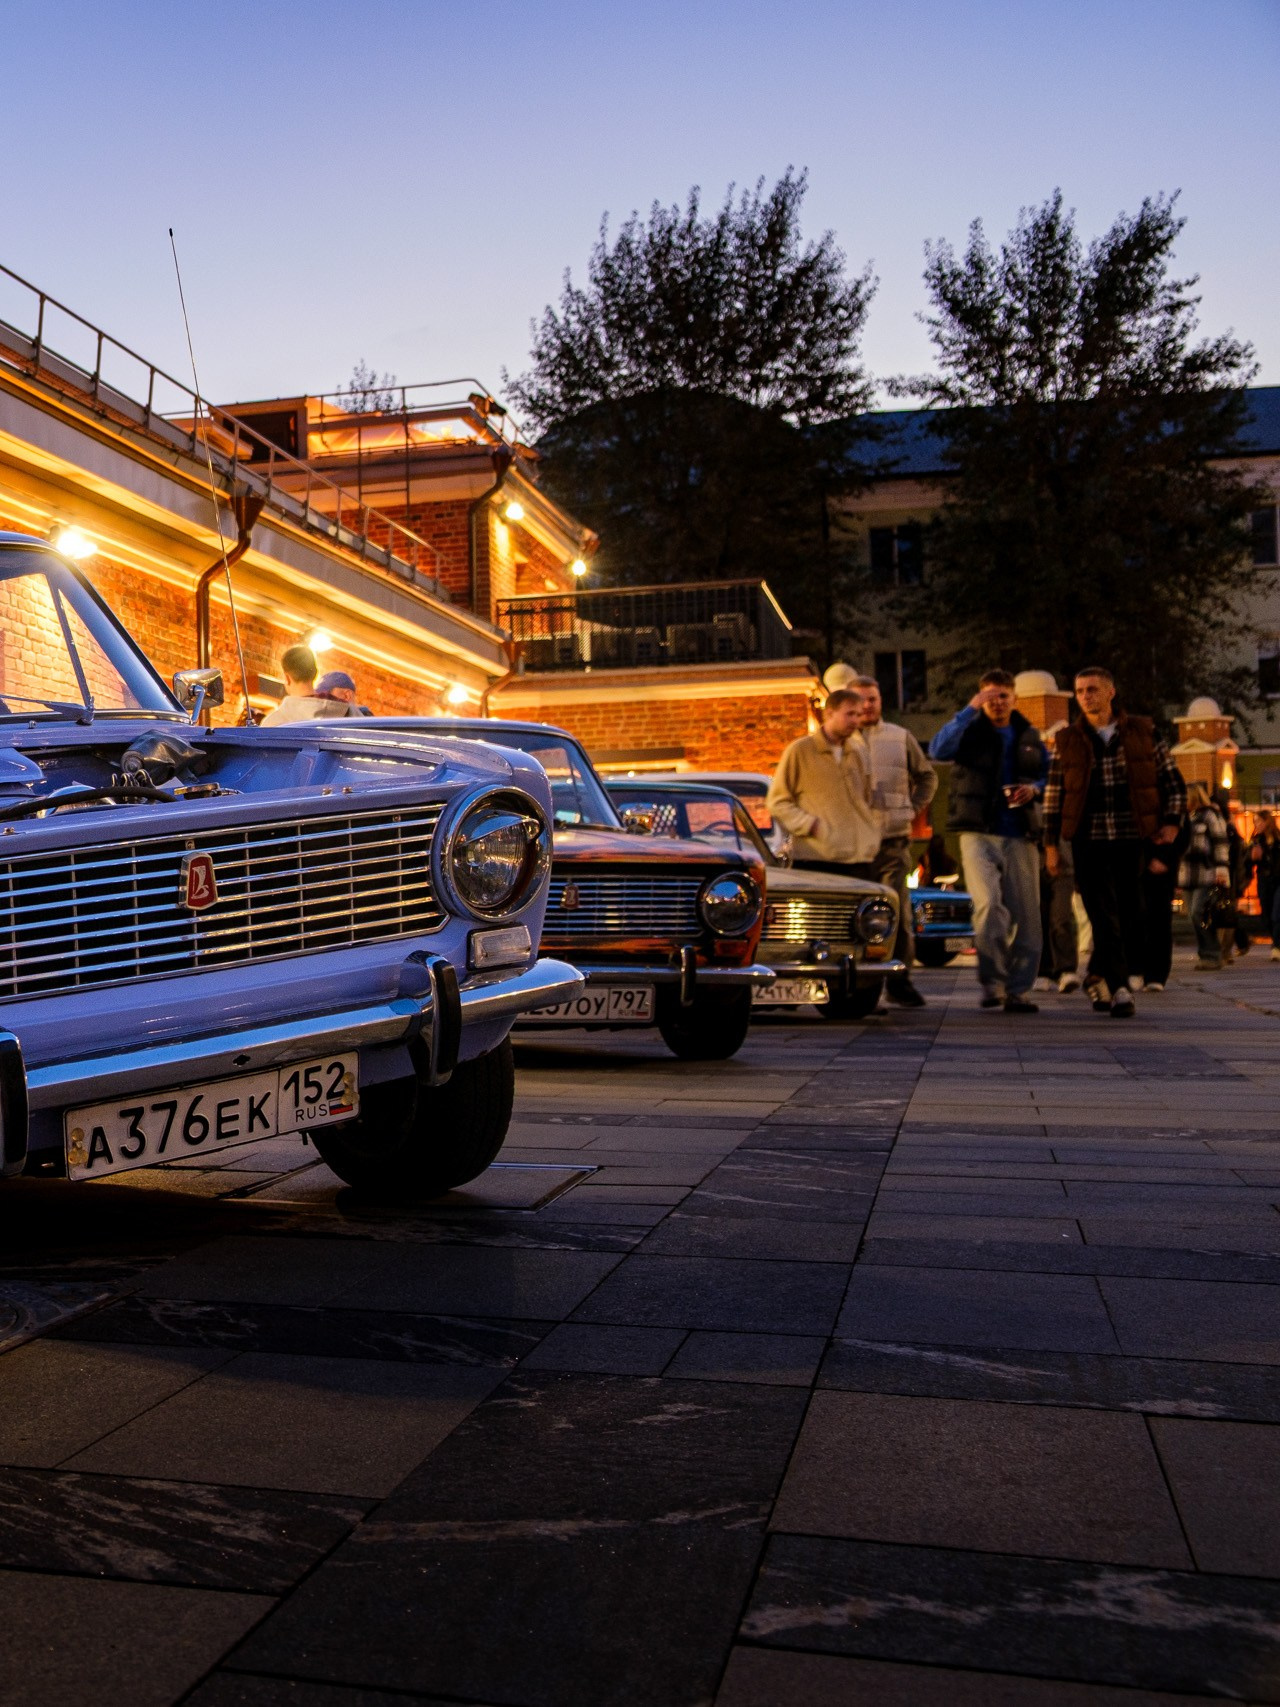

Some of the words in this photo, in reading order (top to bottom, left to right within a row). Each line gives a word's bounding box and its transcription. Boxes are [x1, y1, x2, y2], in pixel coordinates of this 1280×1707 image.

[612, 991, 646, 1009] 797
[86, 1091, 271, 1169] А376ЕК
[283, 1061, 346, 1108] 152
[295, 1104, 328, 1122] RUS
